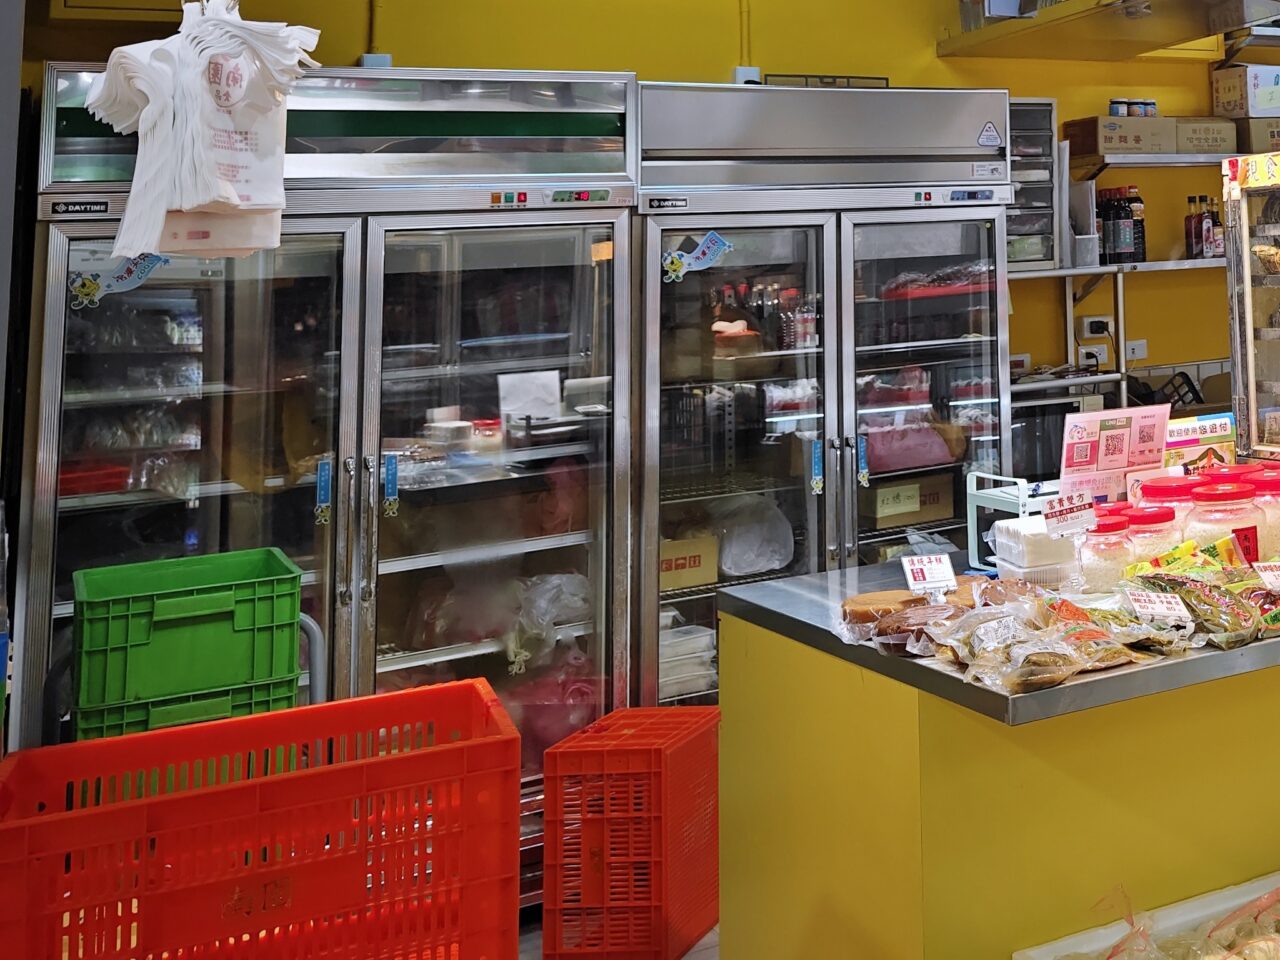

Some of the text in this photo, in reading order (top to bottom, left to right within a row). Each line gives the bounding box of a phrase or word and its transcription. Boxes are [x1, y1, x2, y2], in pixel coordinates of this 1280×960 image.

[68, 204, 106, 212] DAYTIME
[1169, 422, 1228, 438] 歡迎使用悠遊付
[1046, 492, 1086, 510] 富貴雙方
[1056, 515, 1069, 525] 300
